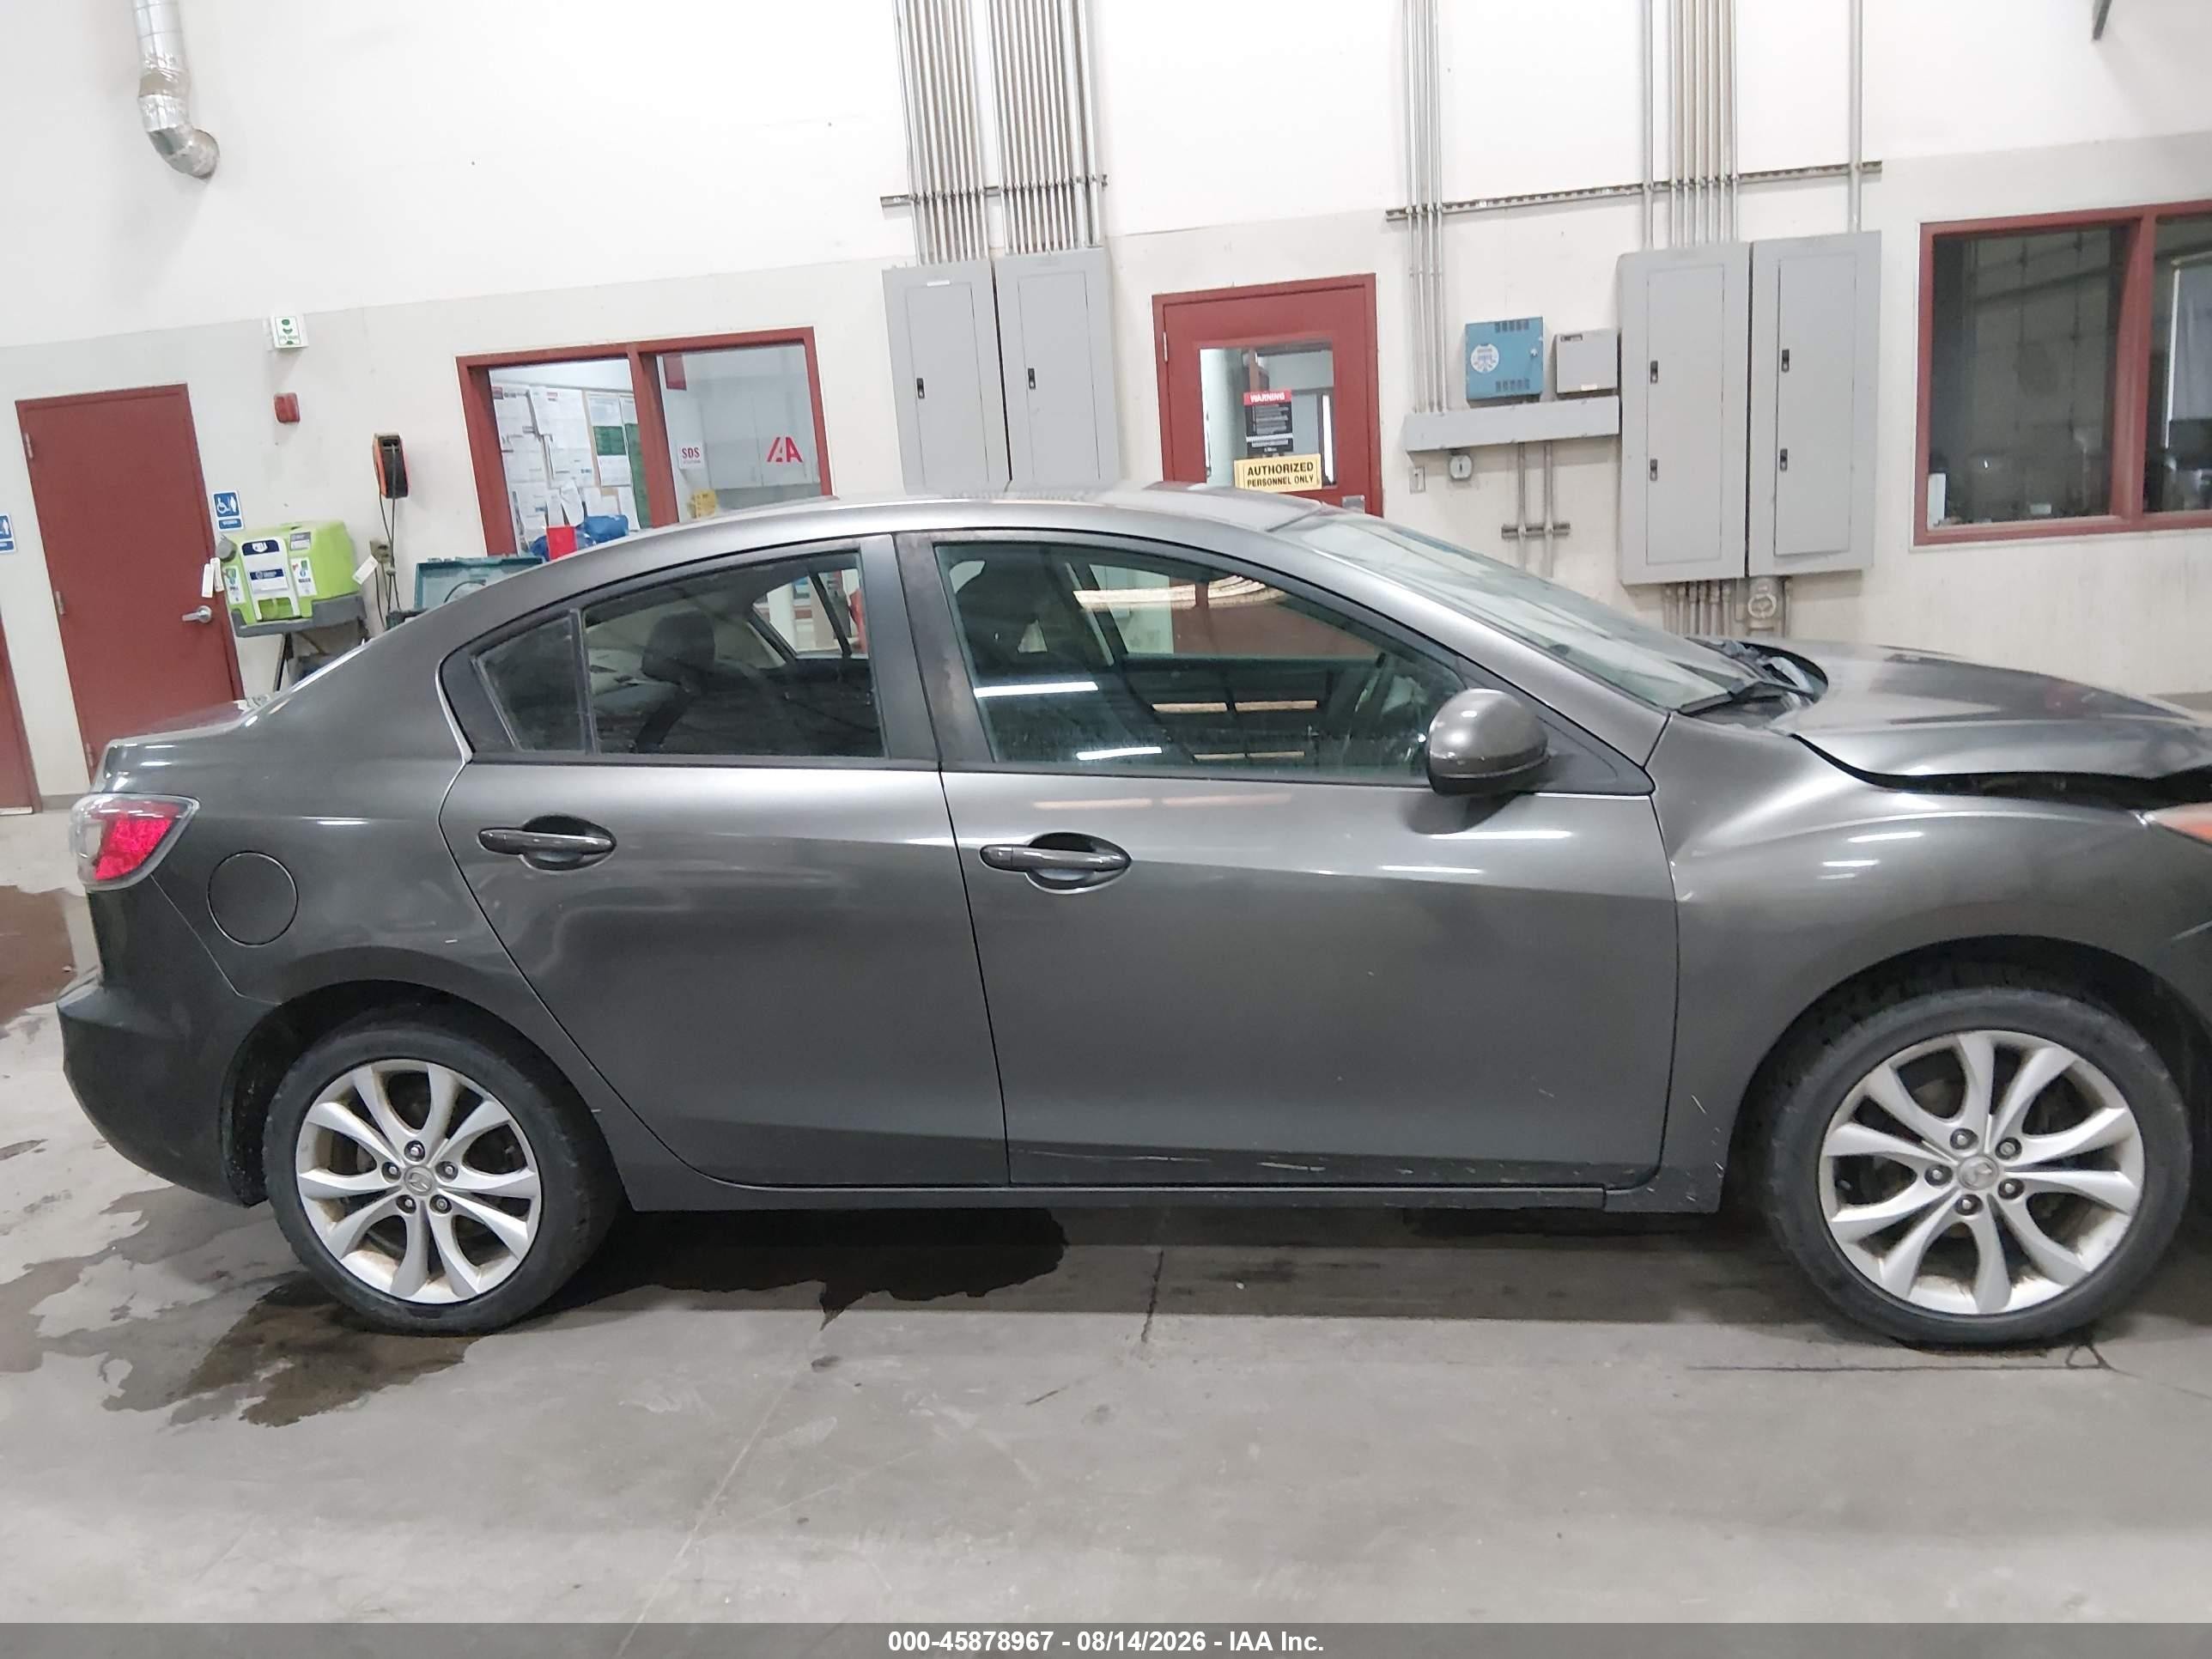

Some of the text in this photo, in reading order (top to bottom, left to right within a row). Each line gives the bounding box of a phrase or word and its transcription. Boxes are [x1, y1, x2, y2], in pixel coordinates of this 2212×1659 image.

[1249, 392, 1285, 403] WARNING
[681, 447, 701, 459] SDS
[1247, 462, 1314, 476] AUTHORIZED
[1247, 474, 1315, 489] PERSONNEL ONLY
